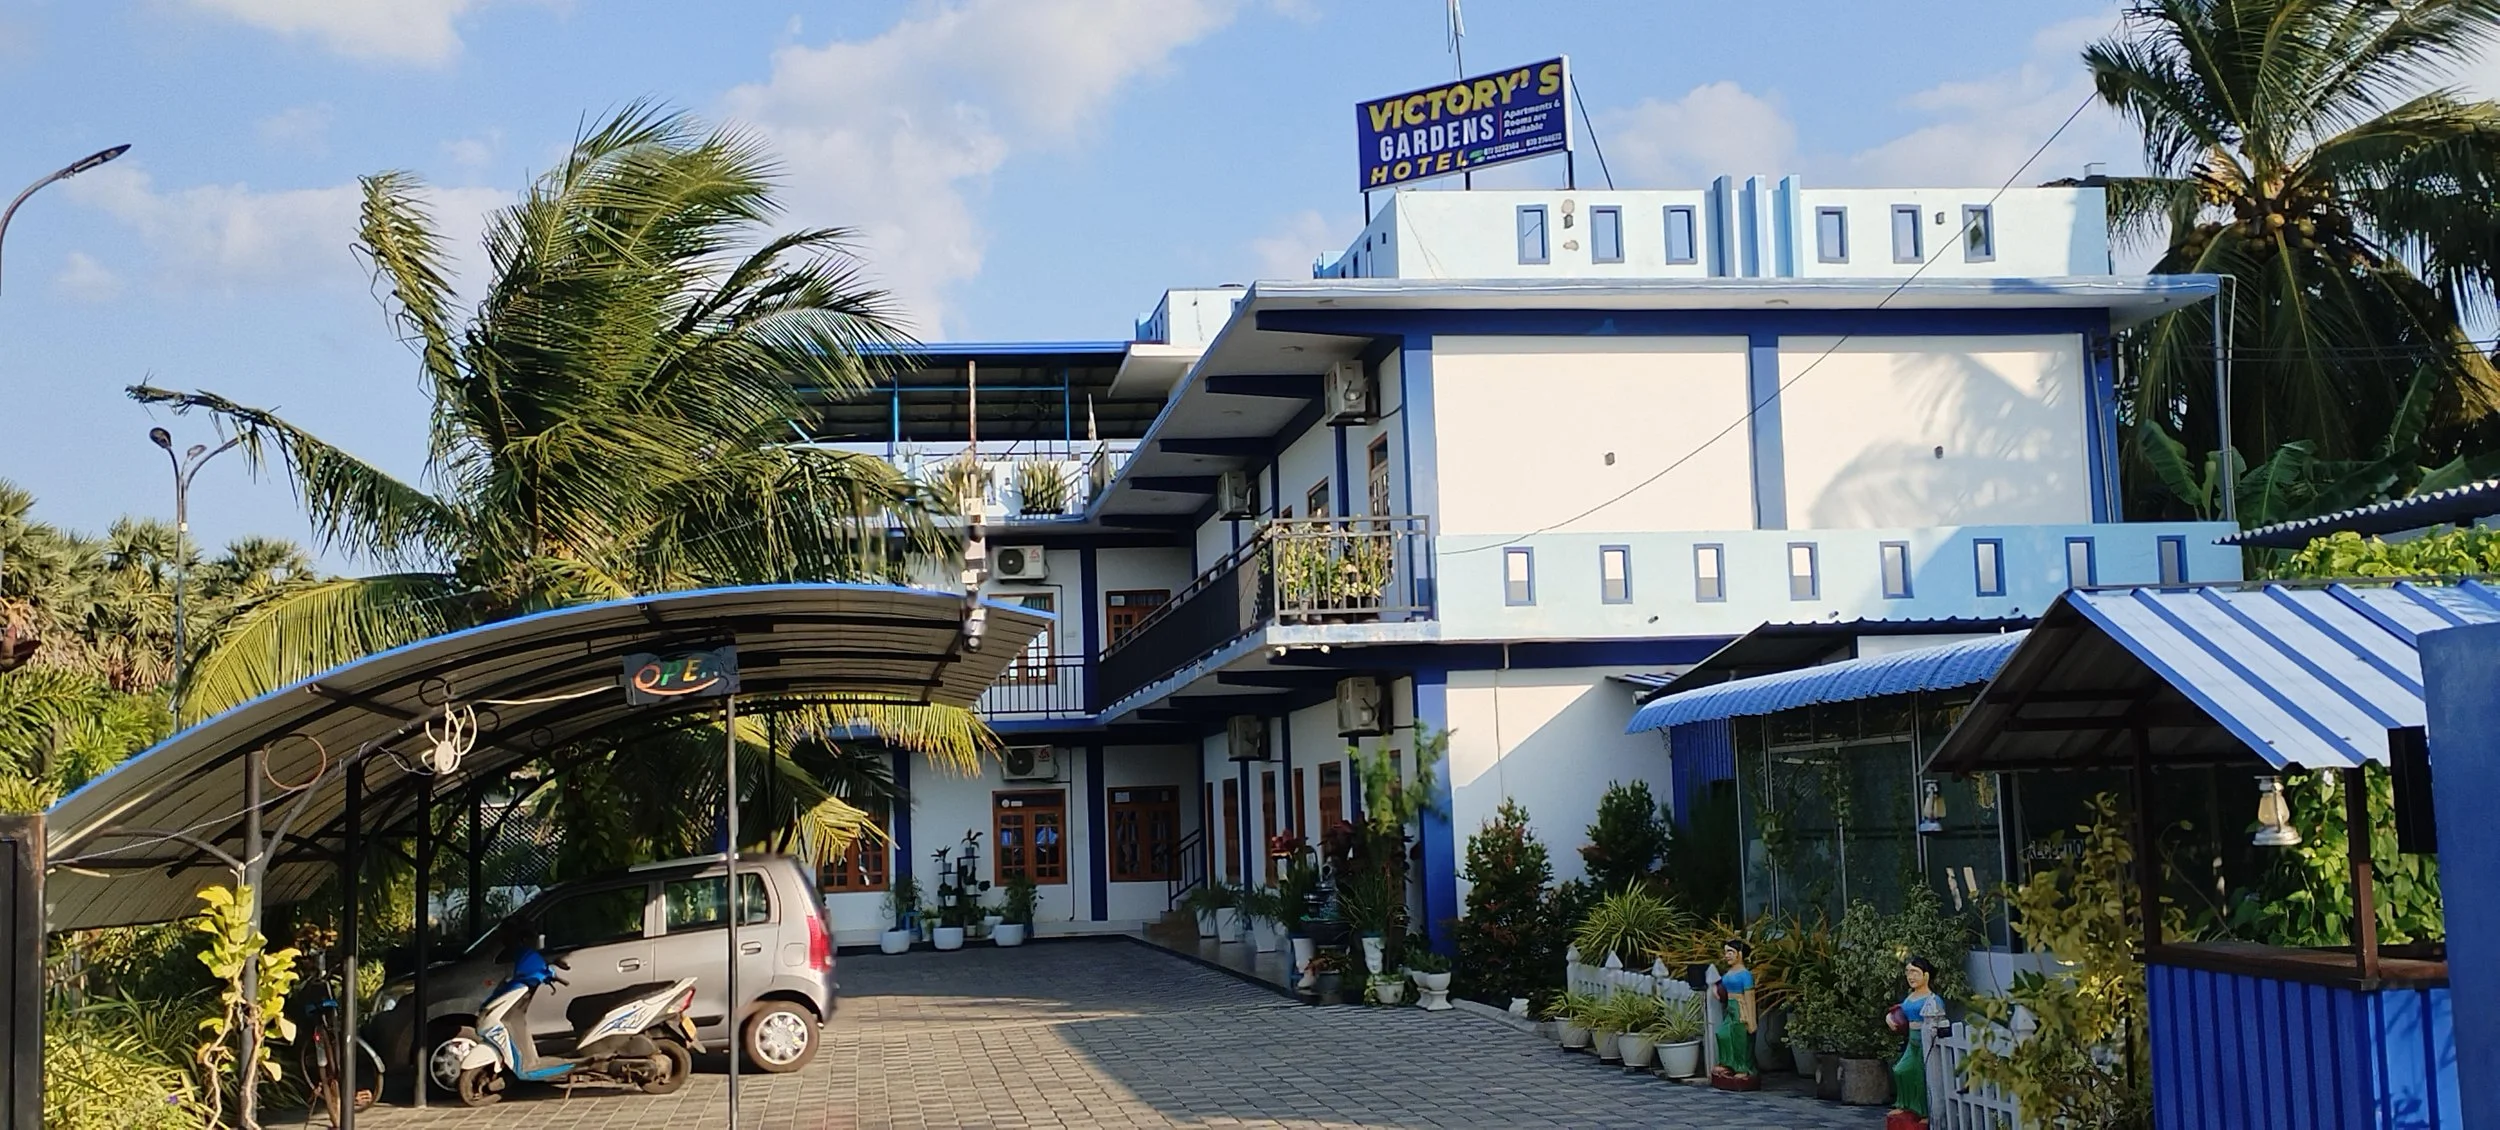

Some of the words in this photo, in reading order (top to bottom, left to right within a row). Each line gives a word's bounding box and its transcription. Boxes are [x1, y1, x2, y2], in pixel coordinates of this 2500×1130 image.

[1504, 102, 1552, 119] Apartments
[1553, 99, 1561, 108] &
[1504, 115, 1532, 128] Rooms
[1533, 113, 1547, 122] are
[1504, 123, 1544, 137] Available
[1379, 114, 1494, 162] GARDENS
[1371, 150, 1468, 185] HOTEL
